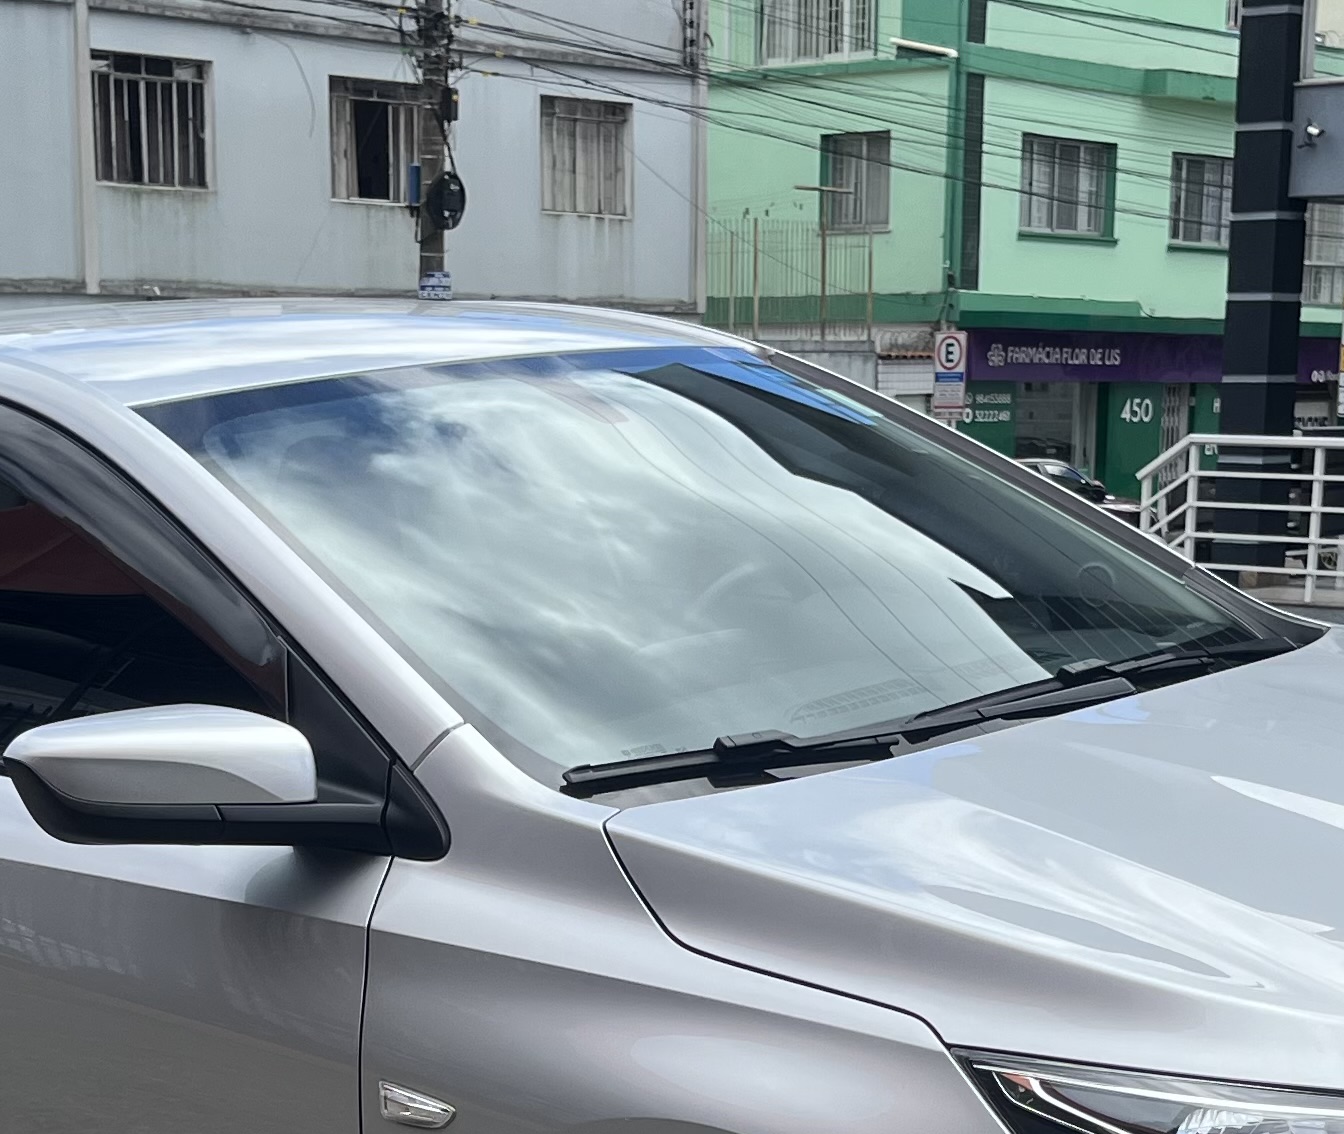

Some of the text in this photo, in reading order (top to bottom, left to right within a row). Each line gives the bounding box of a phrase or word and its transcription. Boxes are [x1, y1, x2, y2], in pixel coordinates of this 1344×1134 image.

[945, 343, 955, 363] E
[1006, 342, 1121, 366] FARMÁCIA FLOR DE LIS
[1119, 398, 1153, 423] 450
